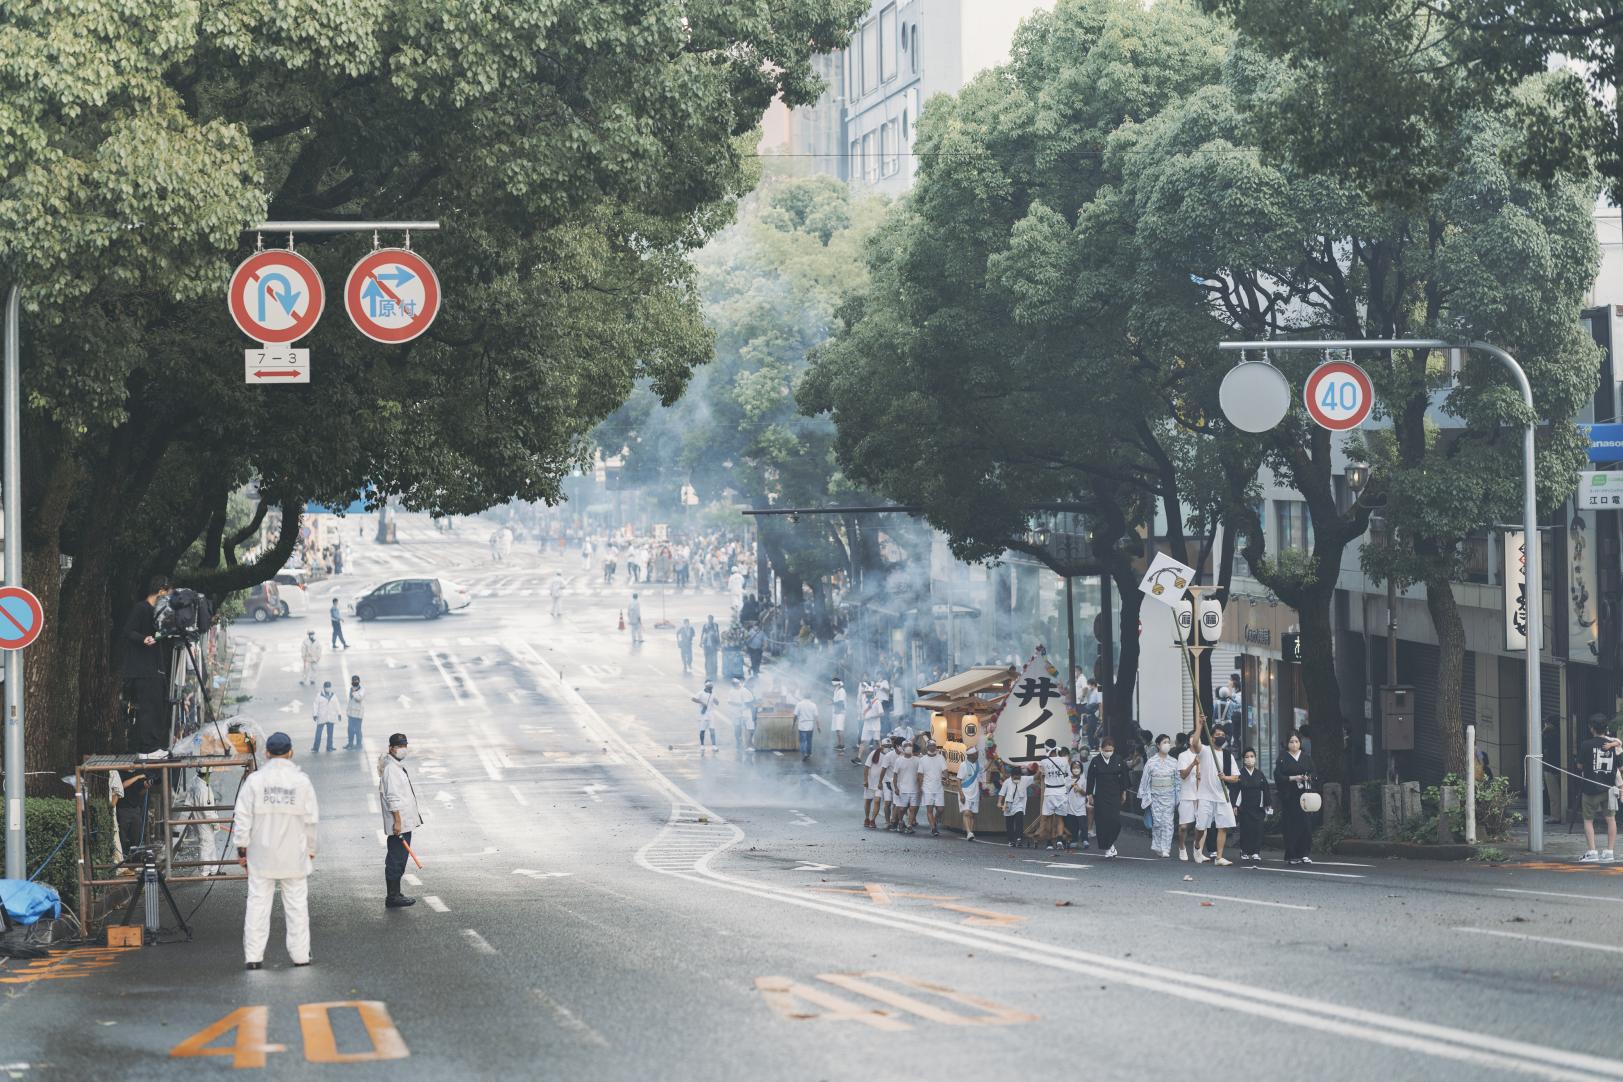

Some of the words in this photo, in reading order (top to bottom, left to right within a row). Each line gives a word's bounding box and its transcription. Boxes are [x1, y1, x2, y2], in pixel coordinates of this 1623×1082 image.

[379, 299, 416, 318] 原付
[1321, 381, 1357, 411] 40
[1008, 676, 1061, 763] 井ノ上
[263, 795, 297, 806] POLICE
[168, 1000, 411, 1069] 40
